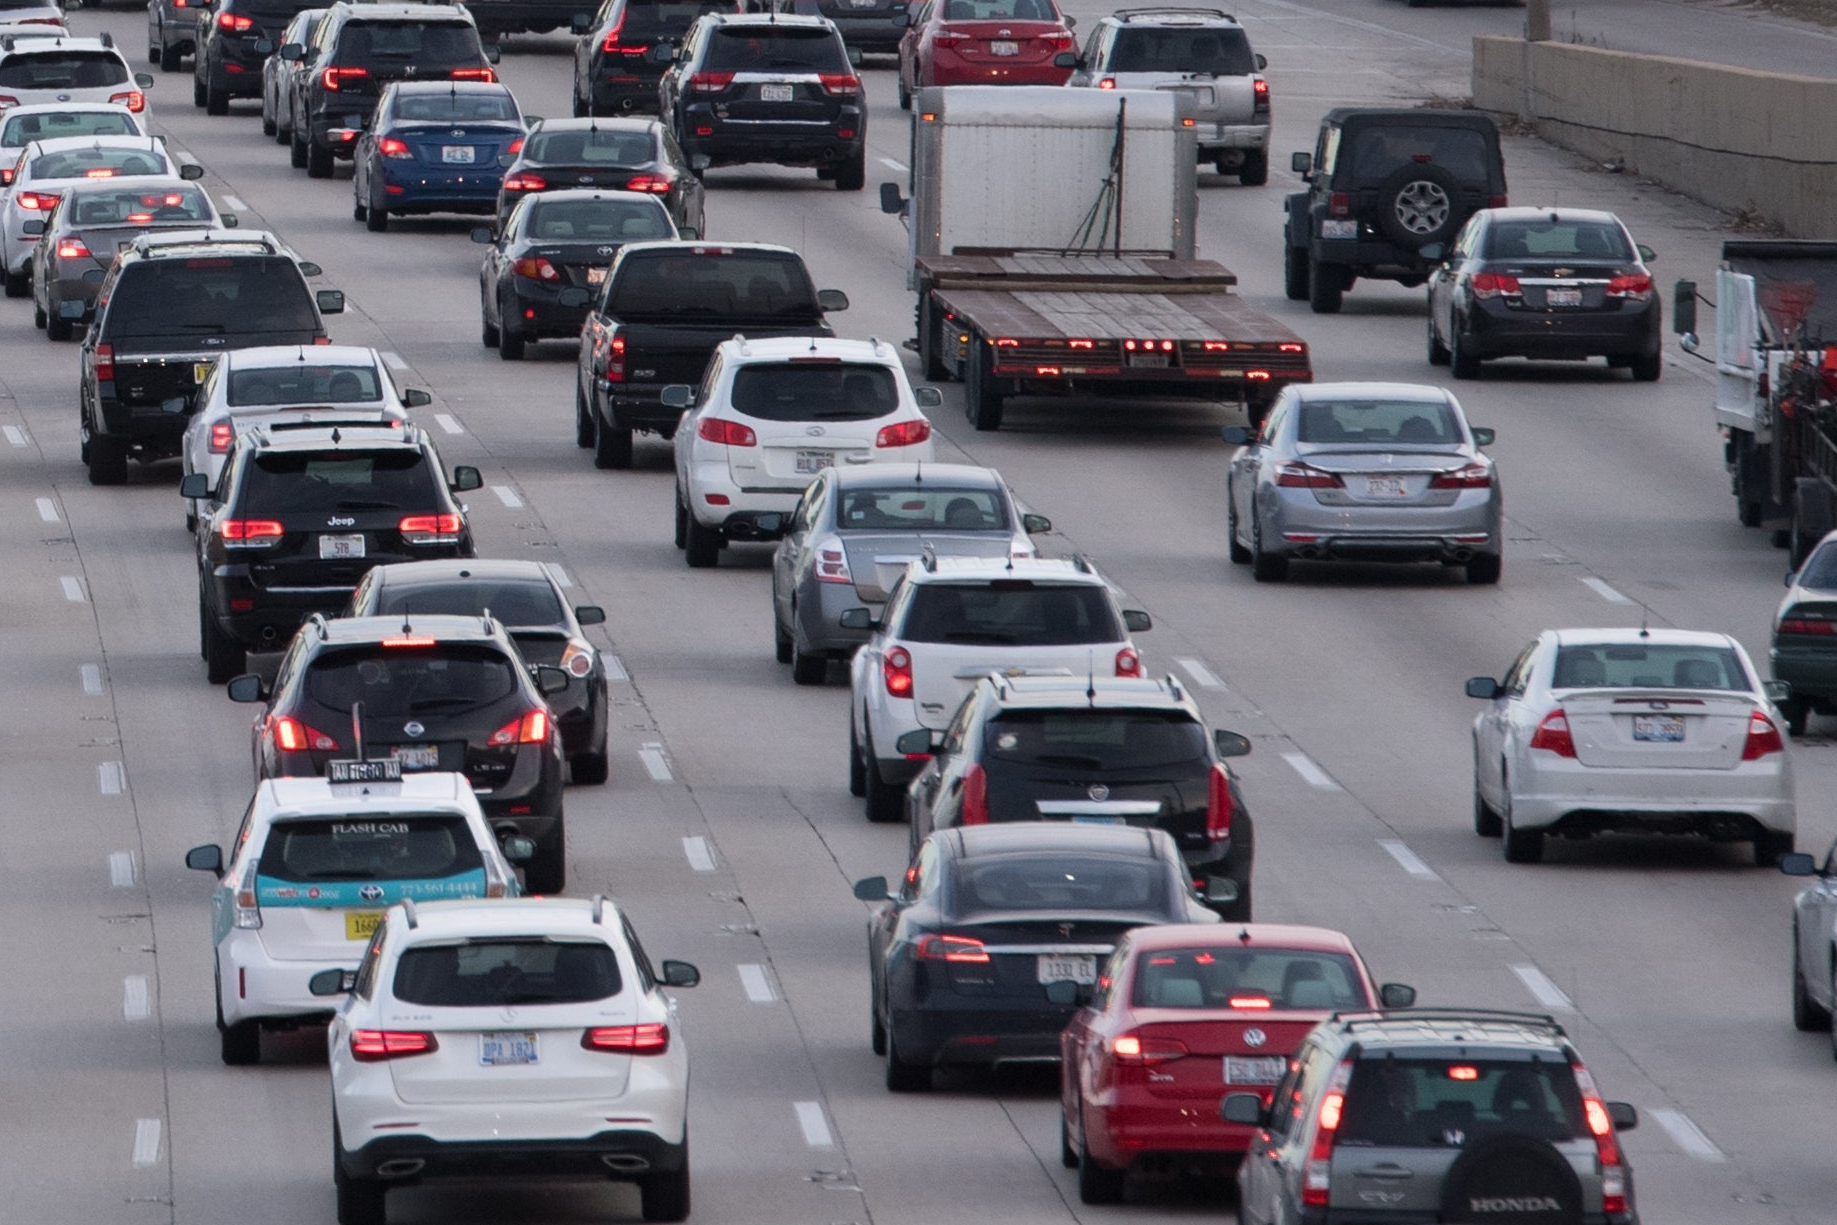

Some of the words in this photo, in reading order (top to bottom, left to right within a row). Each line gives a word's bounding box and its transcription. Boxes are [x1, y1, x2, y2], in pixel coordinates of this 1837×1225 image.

[328, 517, 354, 526] Jeep
[334, 542, 350, 554] 578
[331, 763, 349, 780] TAXI
[384, 762, 401, 779] TAXI
[333, 824, 375, 833] FLASH
[379, 824, 408, 833] CAB
[1471, 1198, 1560, 1211] HONDA
